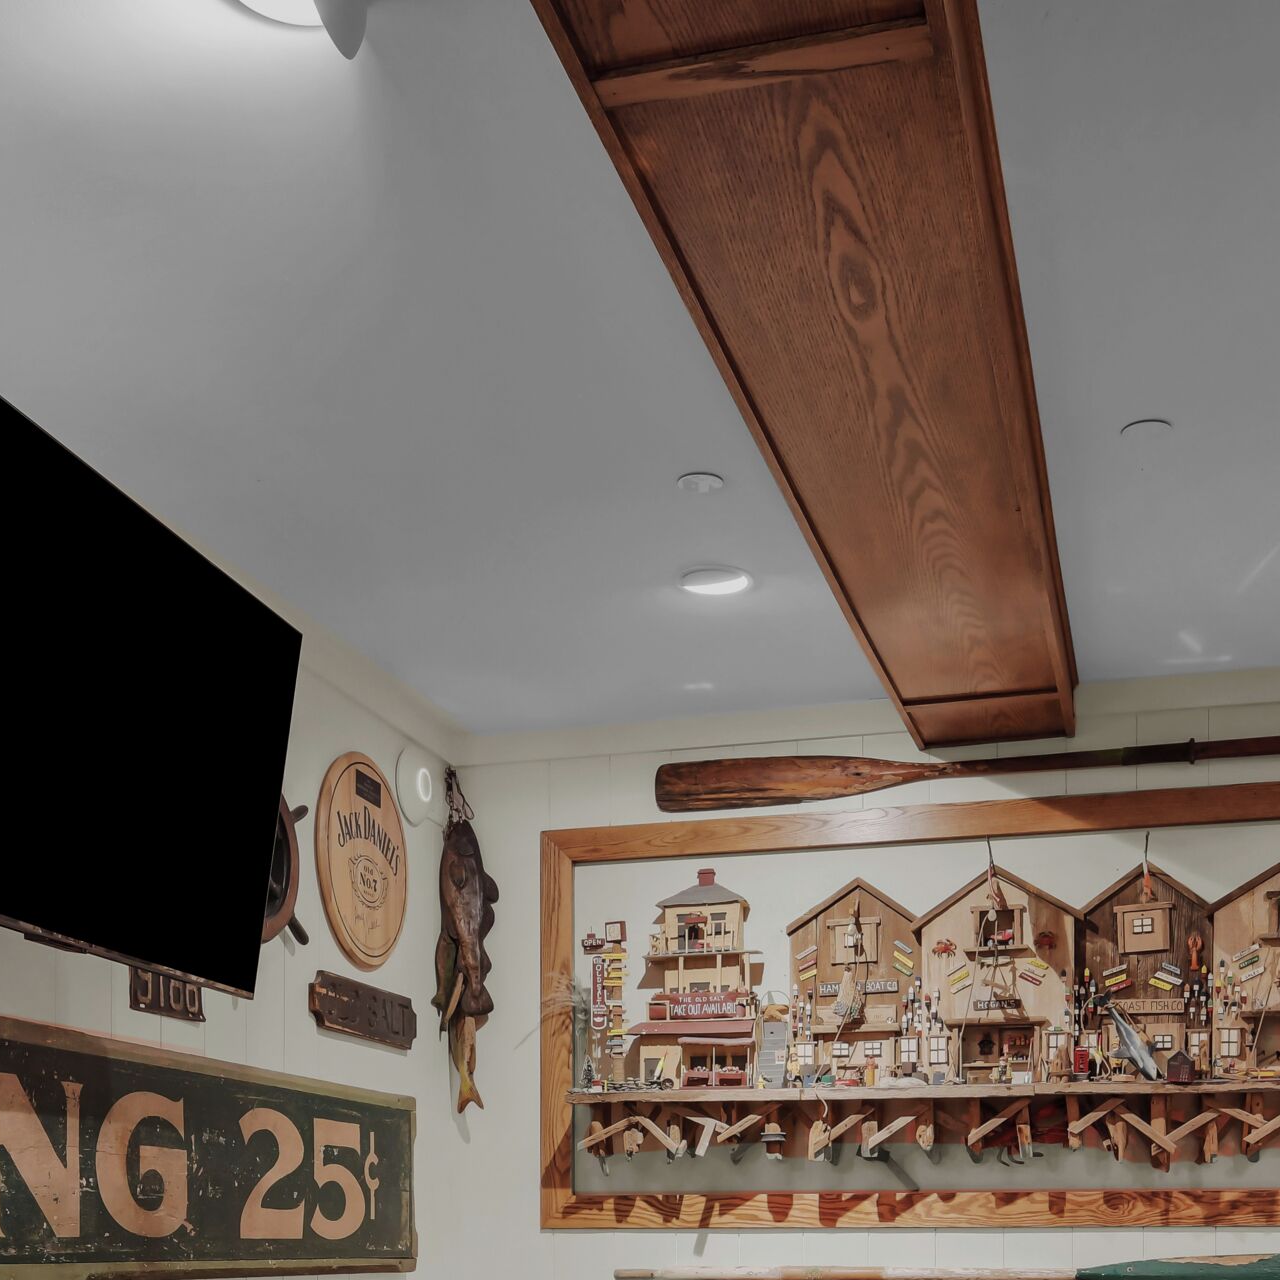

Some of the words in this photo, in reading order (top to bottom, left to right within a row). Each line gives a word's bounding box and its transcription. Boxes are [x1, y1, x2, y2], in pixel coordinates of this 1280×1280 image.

[336, 810, 362, 848] JACK
[363, 804, 401, 877] DANIEL'S
[583, 938, 602, 947] OPEN
[866, 981, 885, 992] BOAT
[670, 1004, 687, 1016] TAKE
[688, 1004, 701, 1015] OUT
[1150, 1000, 1169, 1011] FISH
